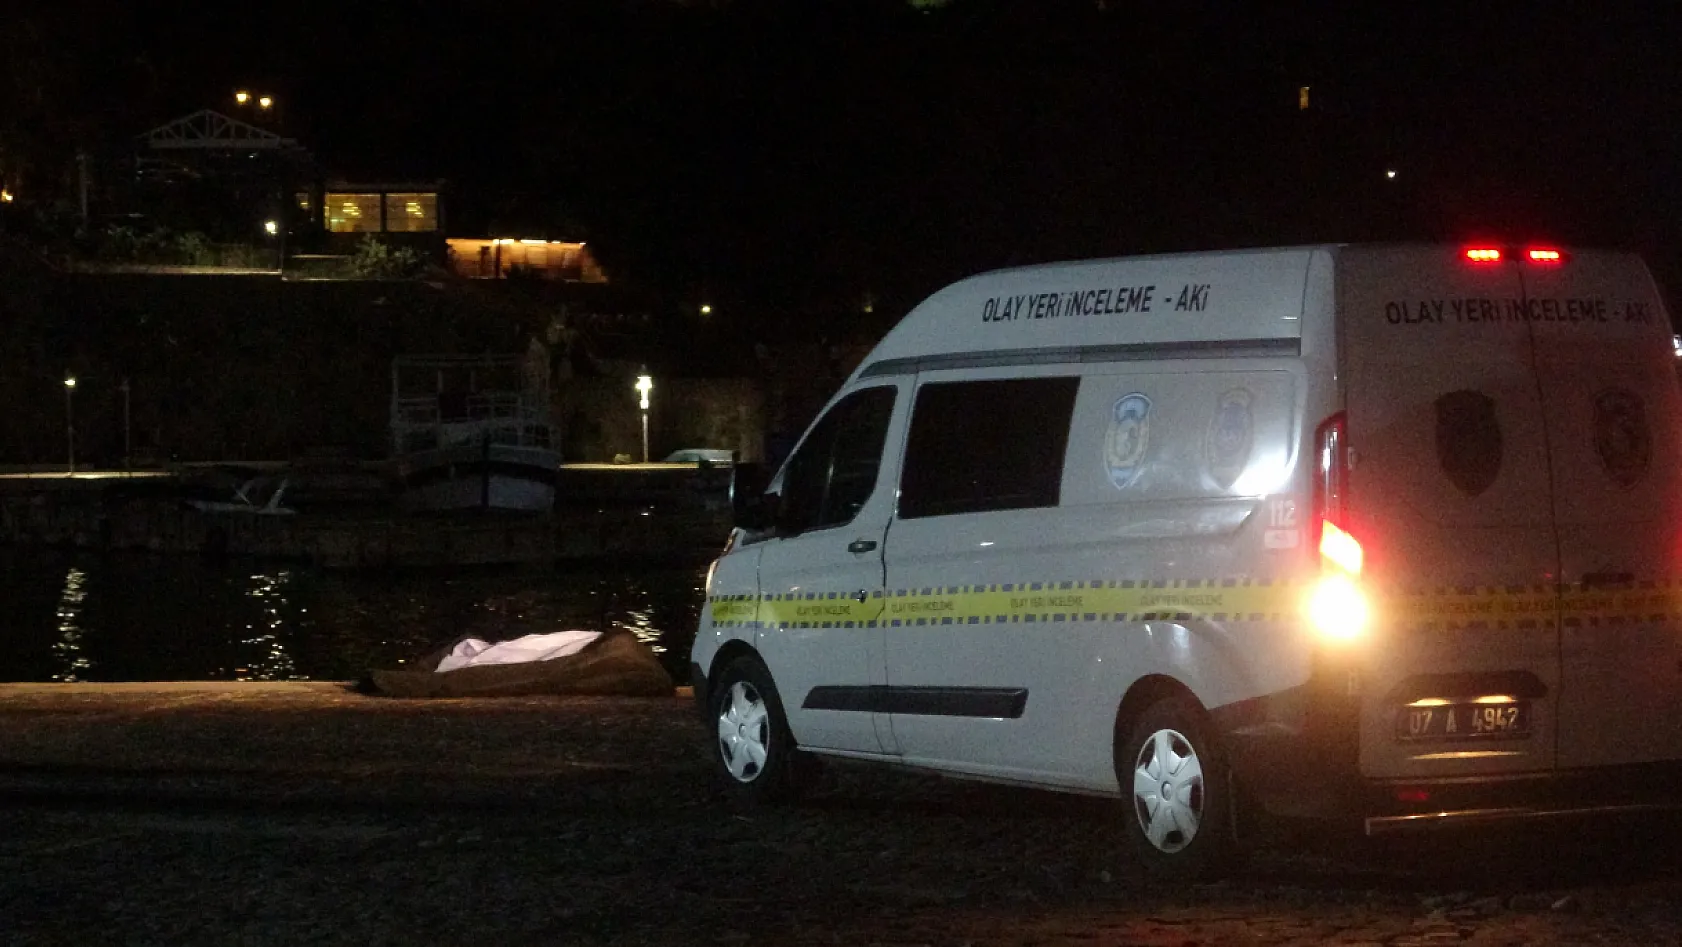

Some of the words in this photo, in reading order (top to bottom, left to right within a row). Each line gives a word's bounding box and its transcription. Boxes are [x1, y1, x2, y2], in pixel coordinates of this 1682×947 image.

[982, 296, 1026, 322] OLAY
[1385, 300, 1444, 324] OLAY
[1270, 499, 1297, 527] 112
[1409, 709, 1433, 734] 07
[1446, 707, 1458, 733] A
[1471, 706, 1520, 733] 4942
